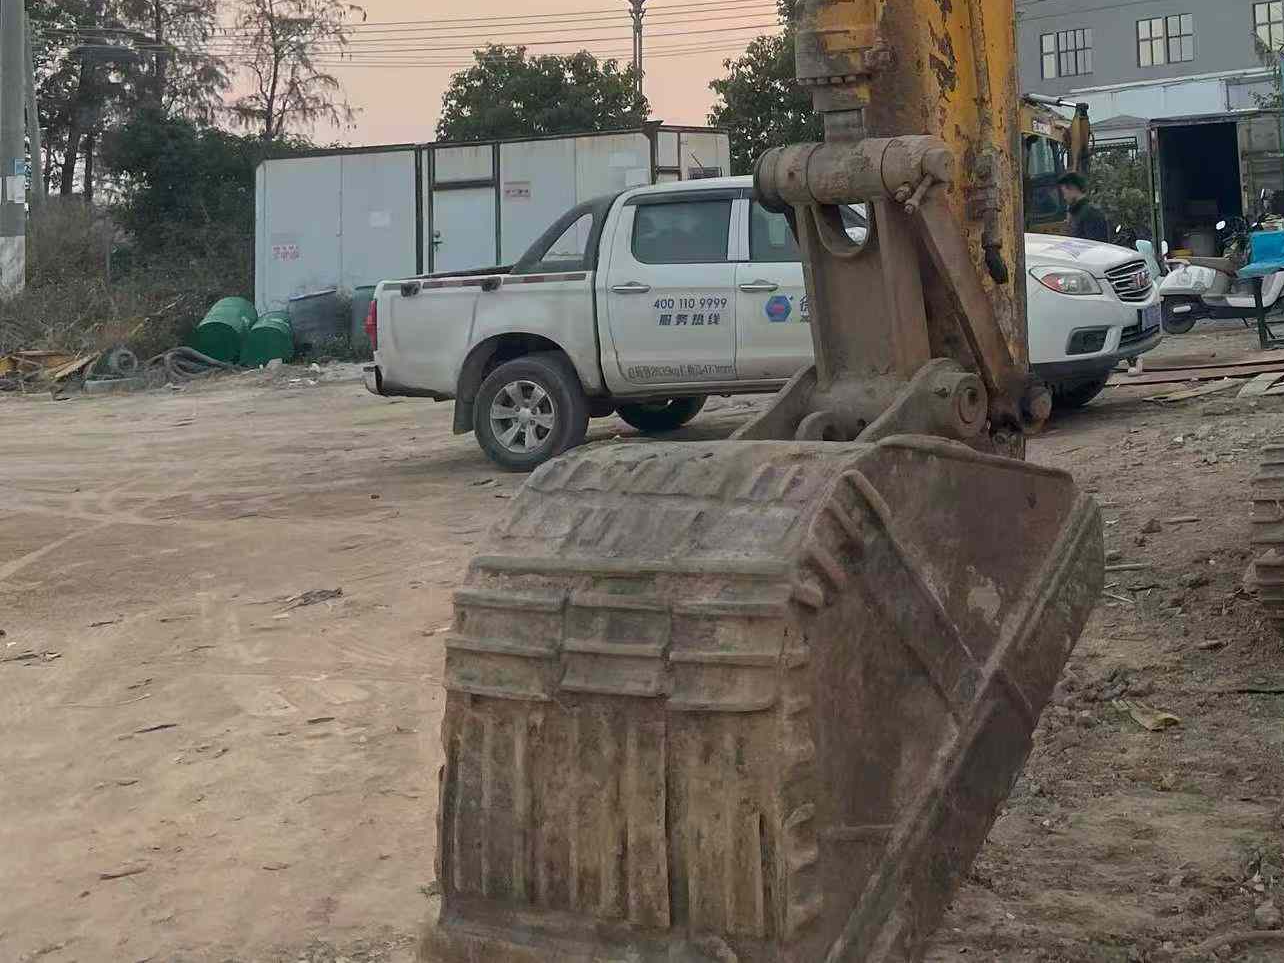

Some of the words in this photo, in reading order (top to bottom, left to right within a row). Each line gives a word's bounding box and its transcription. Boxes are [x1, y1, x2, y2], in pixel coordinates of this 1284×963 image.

[654, 298, 675, 310] 400
[679, 298, 695, 309] 110
[699, 297, 728, 309] 9999
